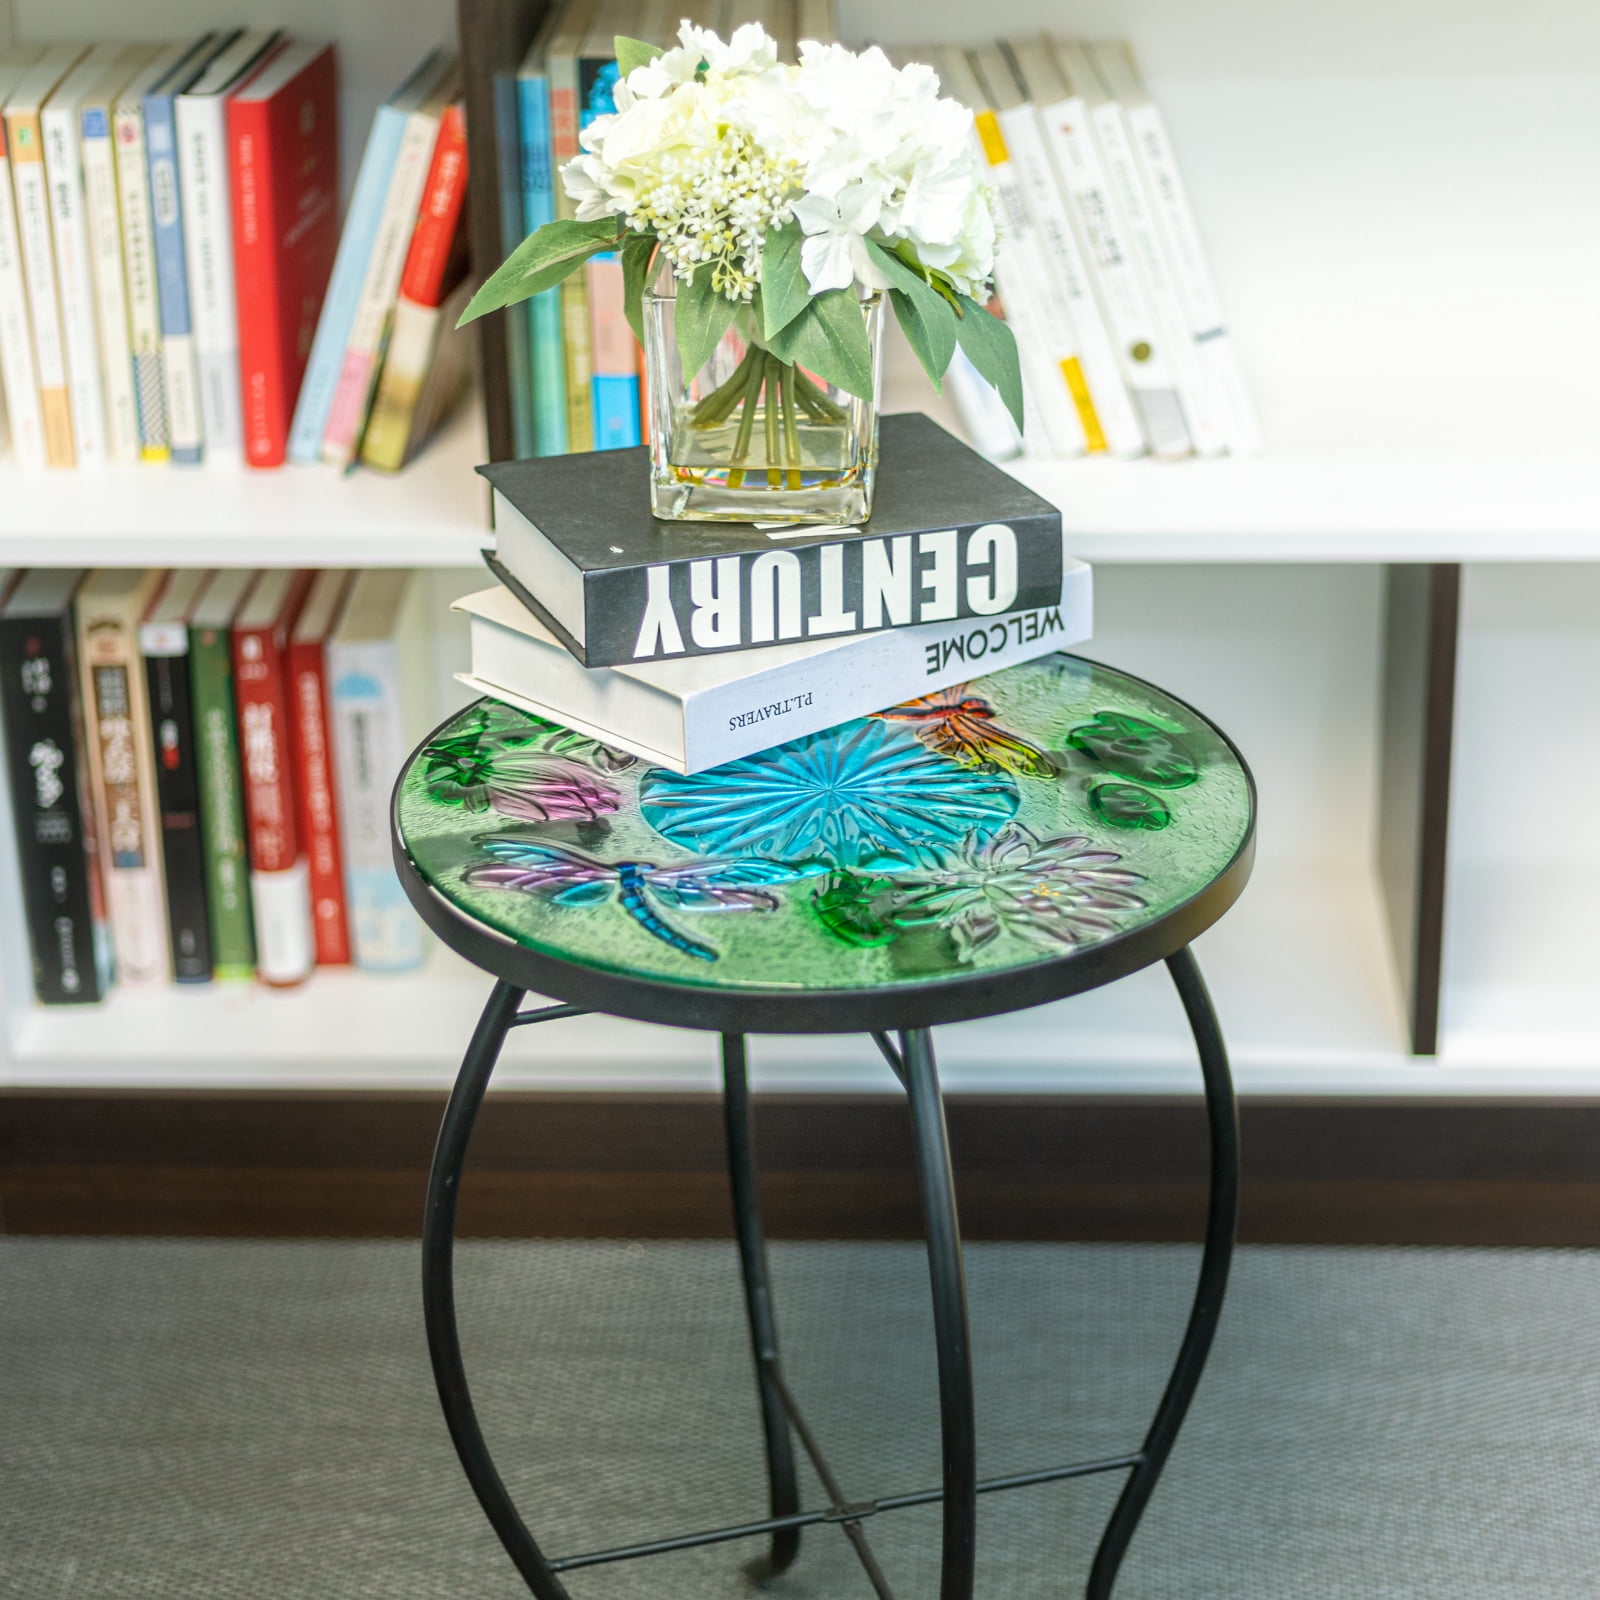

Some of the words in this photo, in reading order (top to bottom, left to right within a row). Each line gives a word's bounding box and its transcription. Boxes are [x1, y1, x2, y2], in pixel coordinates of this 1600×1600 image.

[633, 523, 1019, 658] CENTURY
[925, 607, 1065, 676] WELCOME
[728, 692, 814, 732] P.L.TRAVERS
